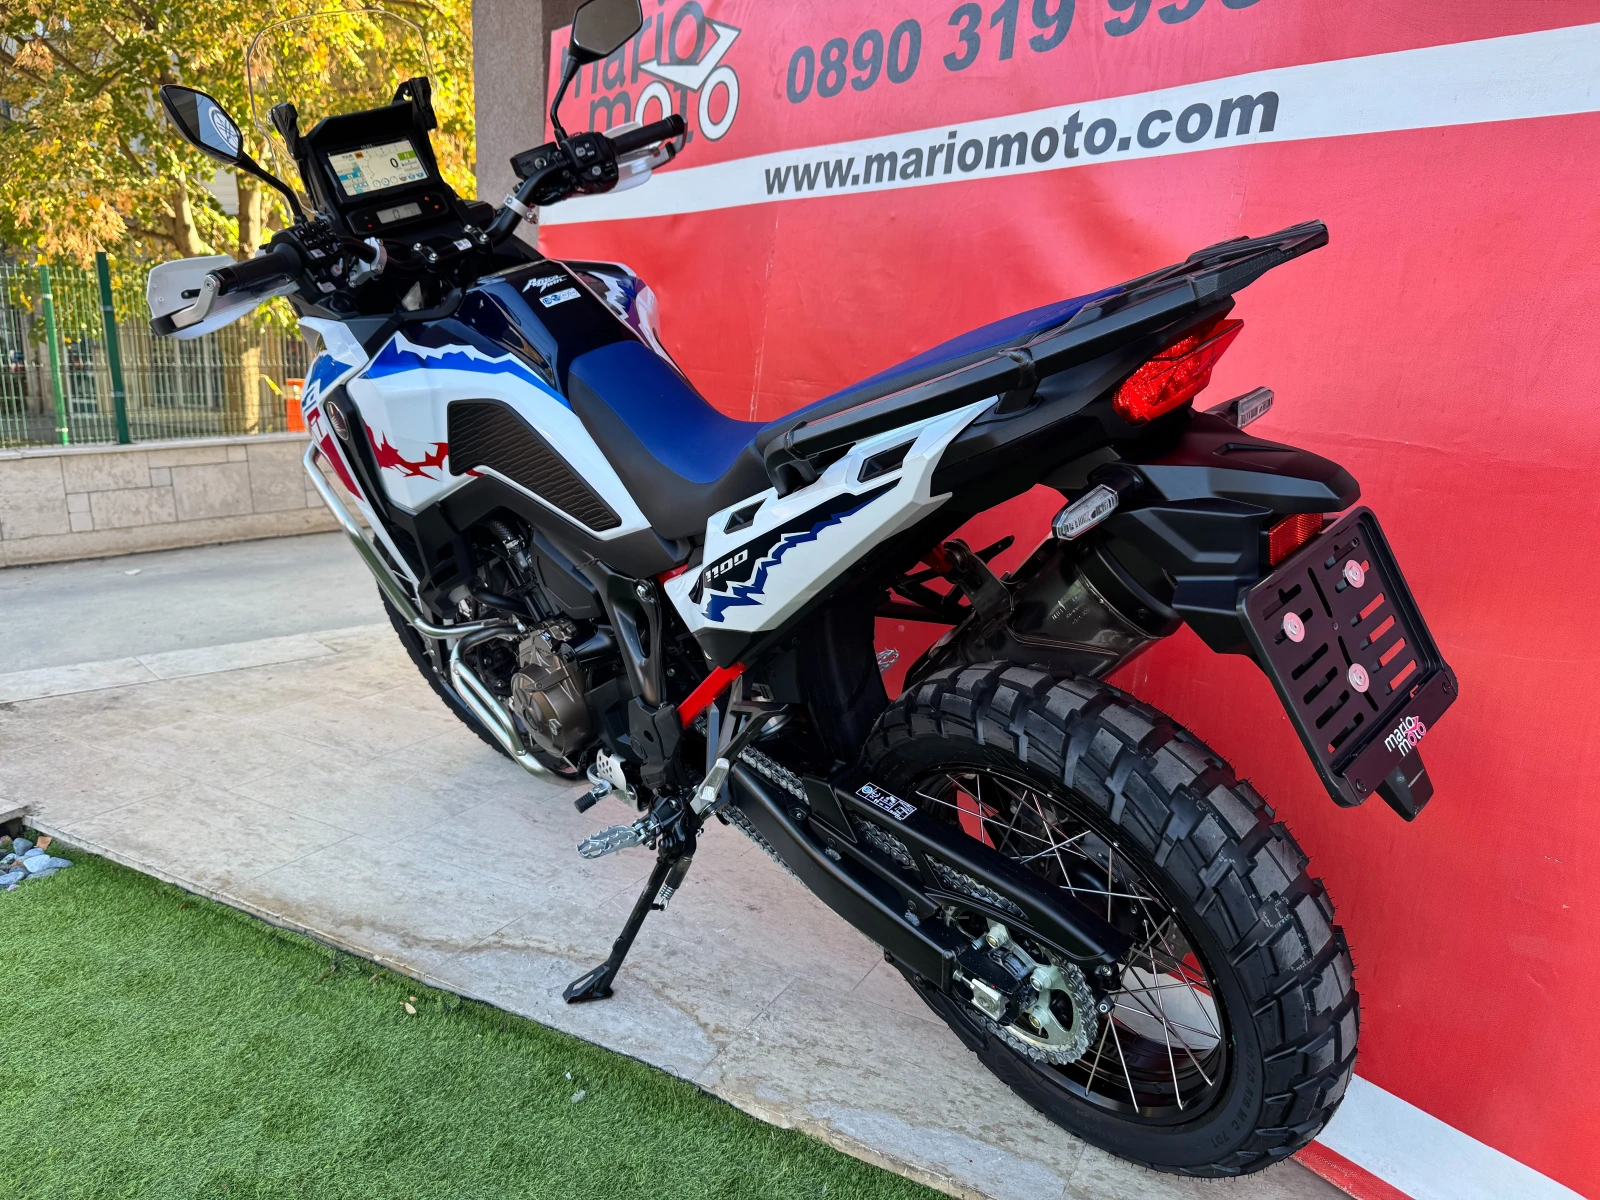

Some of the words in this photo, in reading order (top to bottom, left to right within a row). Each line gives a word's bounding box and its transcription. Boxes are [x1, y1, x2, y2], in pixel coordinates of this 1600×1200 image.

[786, 19, 922, 104] 0890
[942, 0, 1076, 72] 319
[764, 91, 1280, 195] www.mariomoto.com
[705, 549, 748, 582] 1100
[1384, 716, 1414, 752] mario
[1398, 722, 1427, 757] moto
